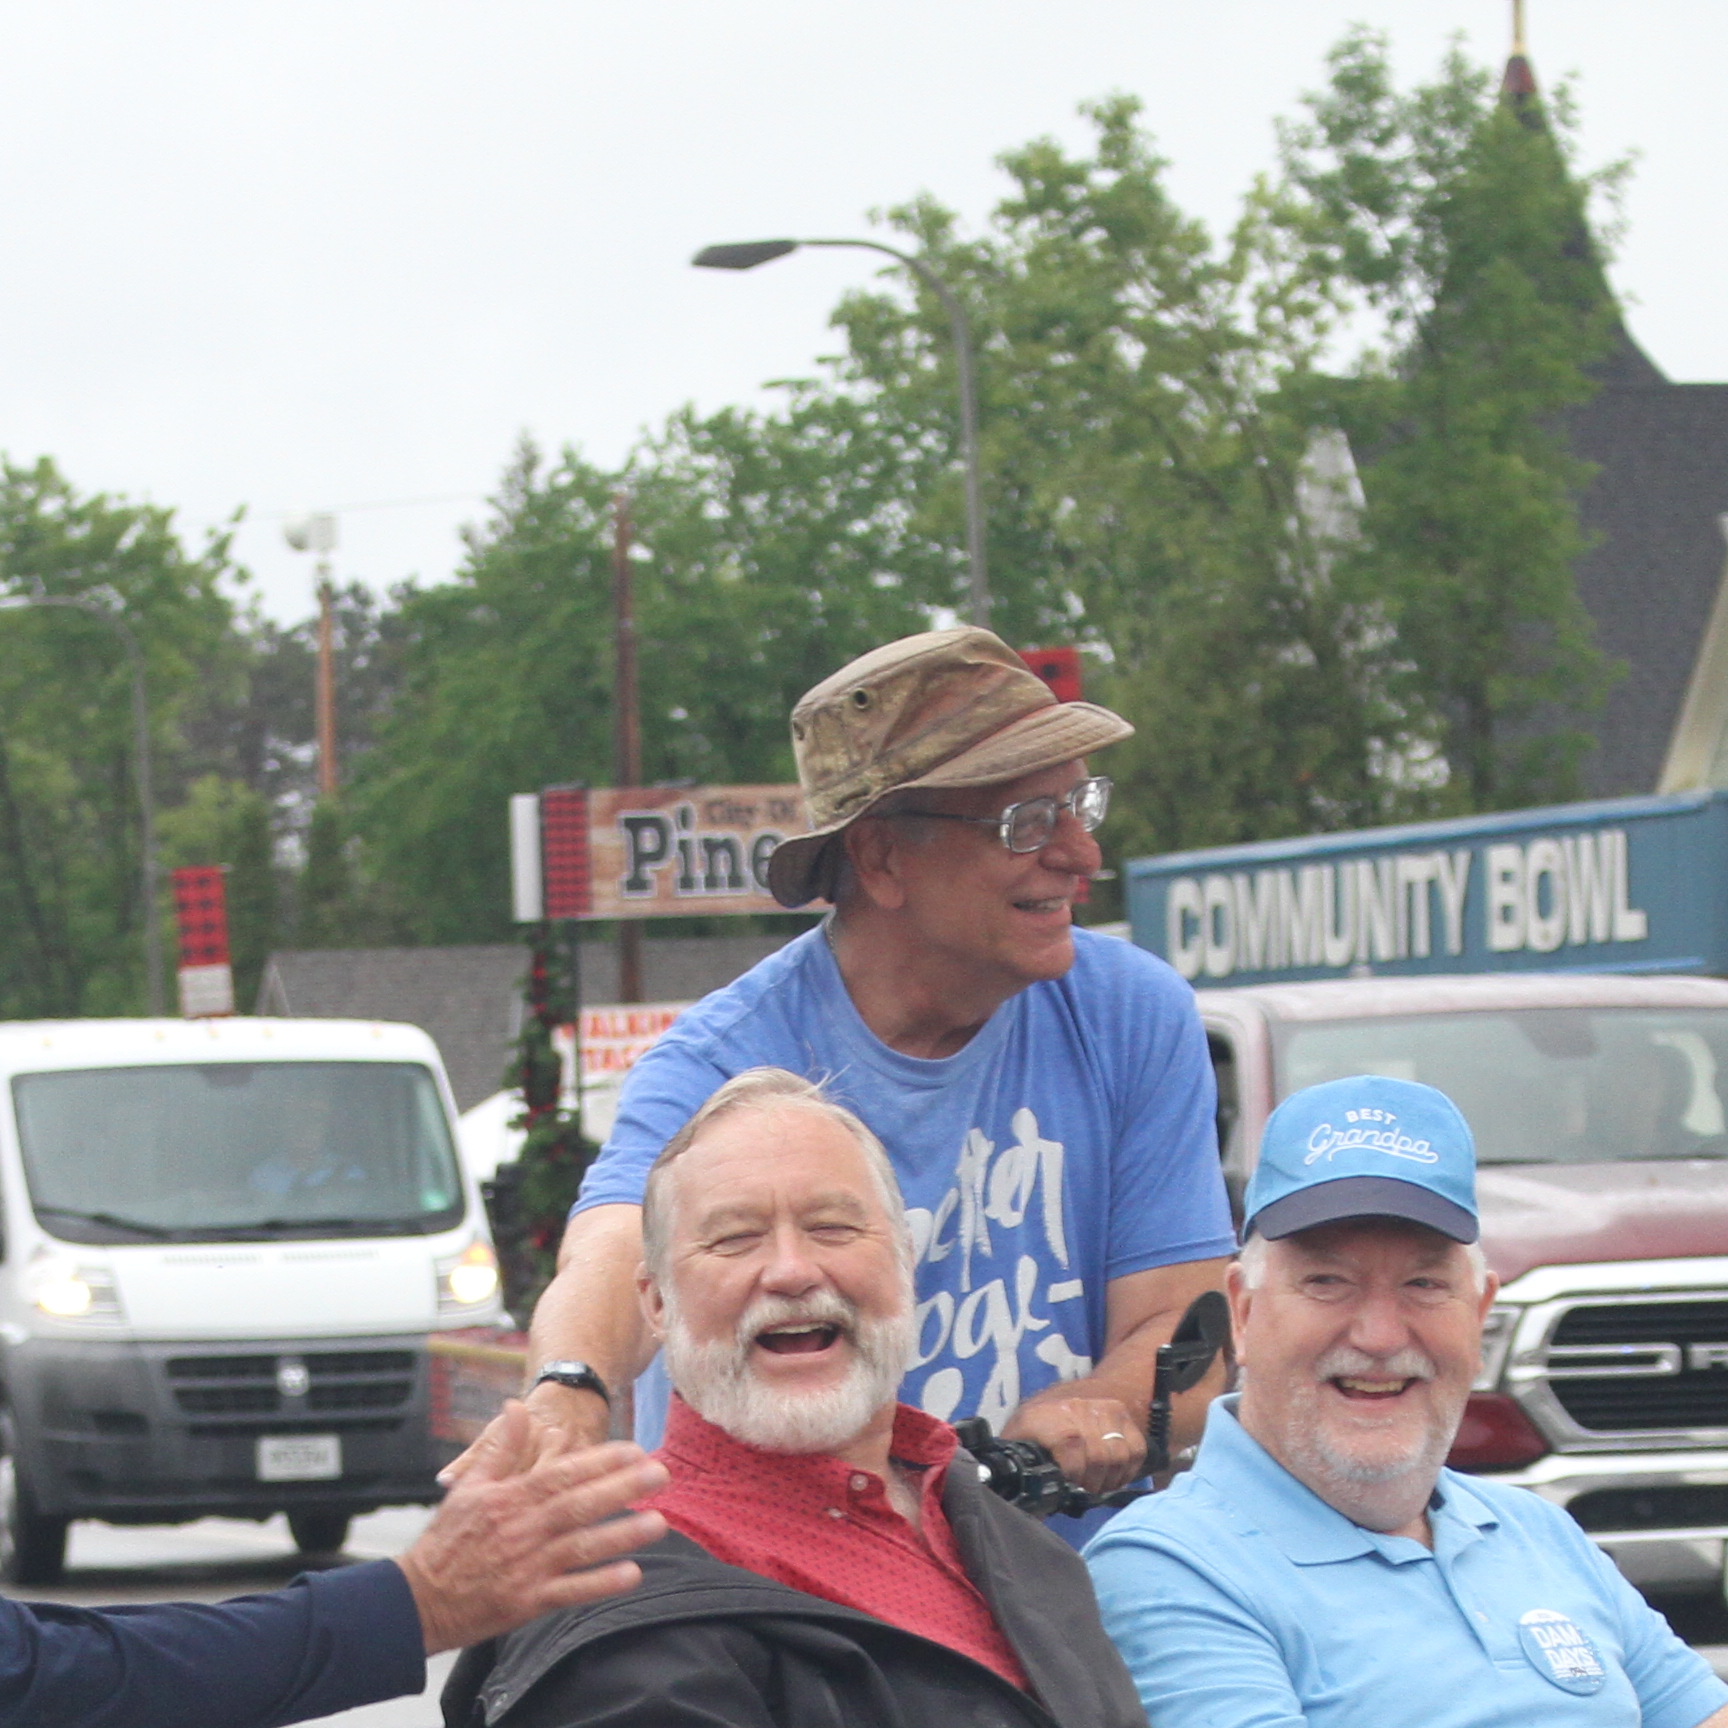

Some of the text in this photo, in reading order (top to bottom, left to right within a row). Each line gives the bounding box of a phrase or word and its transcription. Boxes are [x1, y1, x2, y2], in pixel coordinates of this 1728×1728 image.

[621, 803, 780, 893] Pine
[1166, 829, 1648, 980] COMMUNITY BOWL
[1345, 1107, 1397, 1126] BEST
[1303, 1123, 1439, 1166] Grandpa
[1529, 1623, 1585, 1649] DAM
[1543, 1646, 1599, 1669] DAYS
